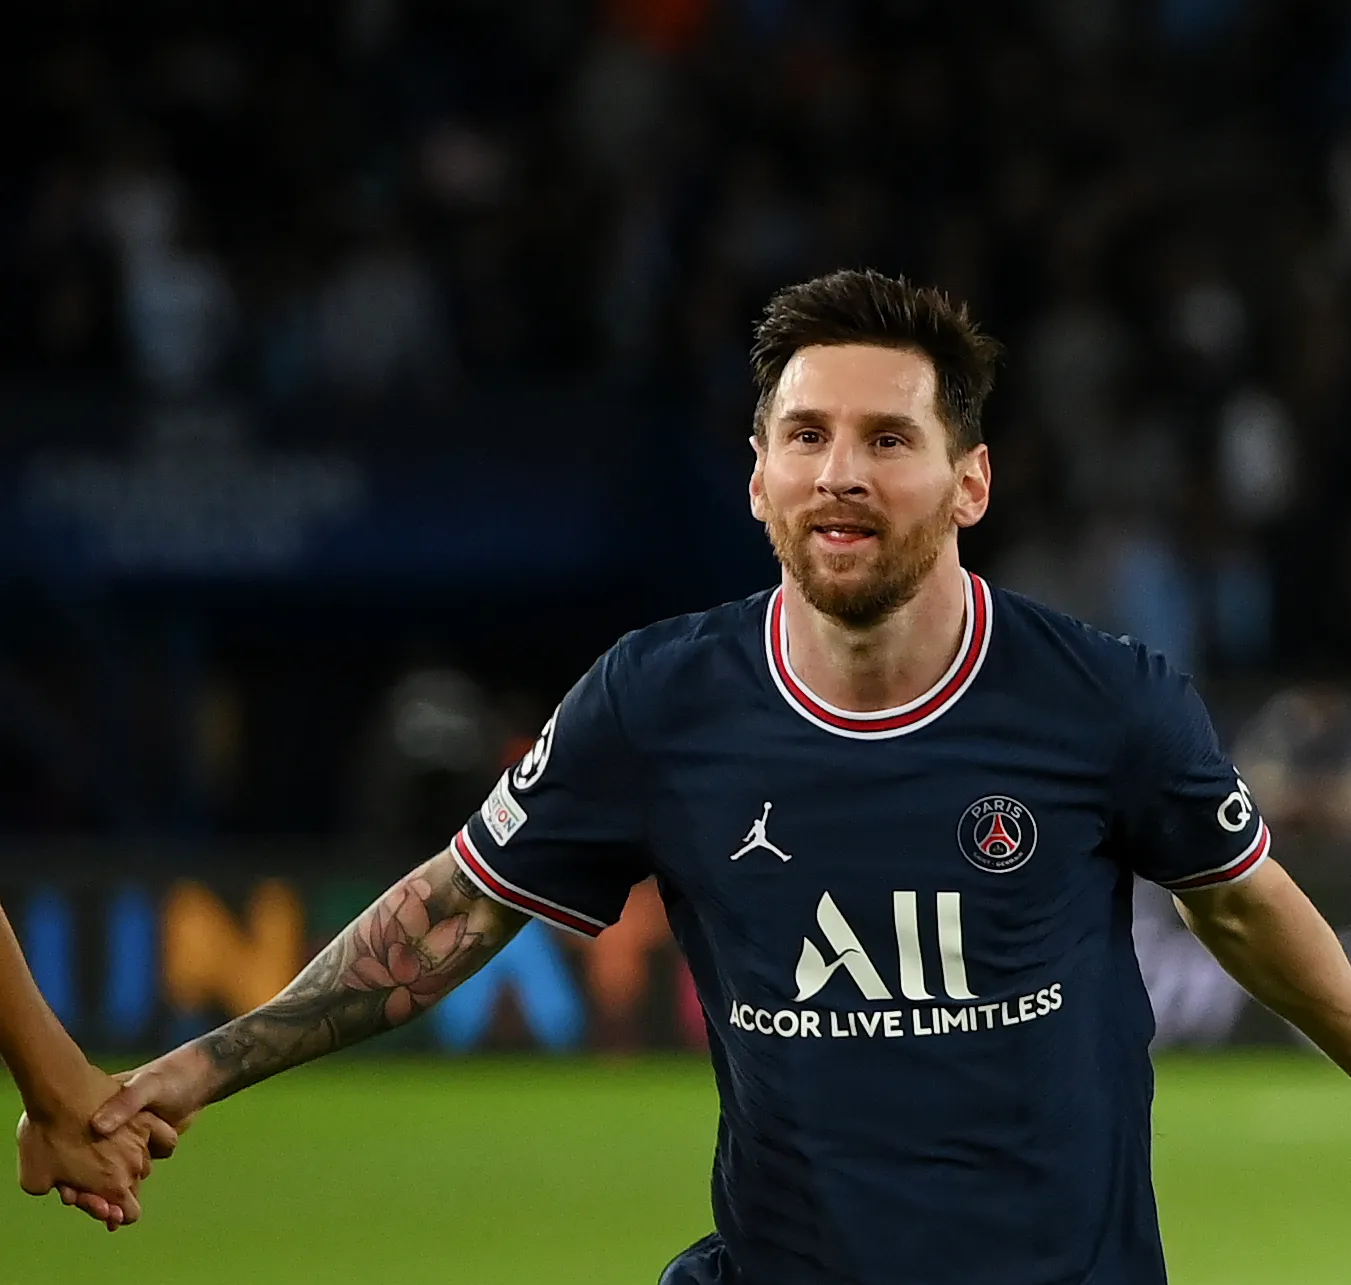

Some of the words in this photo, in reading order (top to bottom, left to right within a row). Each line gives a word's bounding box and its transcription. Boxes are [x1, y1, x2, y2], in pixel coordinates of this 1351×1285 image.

[971, 799, 1023, 819] PARIS
[1217, 764, 1253, 832] QN
[729, 997, 822, 1038] ACCOR
[830, 1010, 904, 1038] LIVE
[912, 983, 1063, 1036] LIMITLESS
